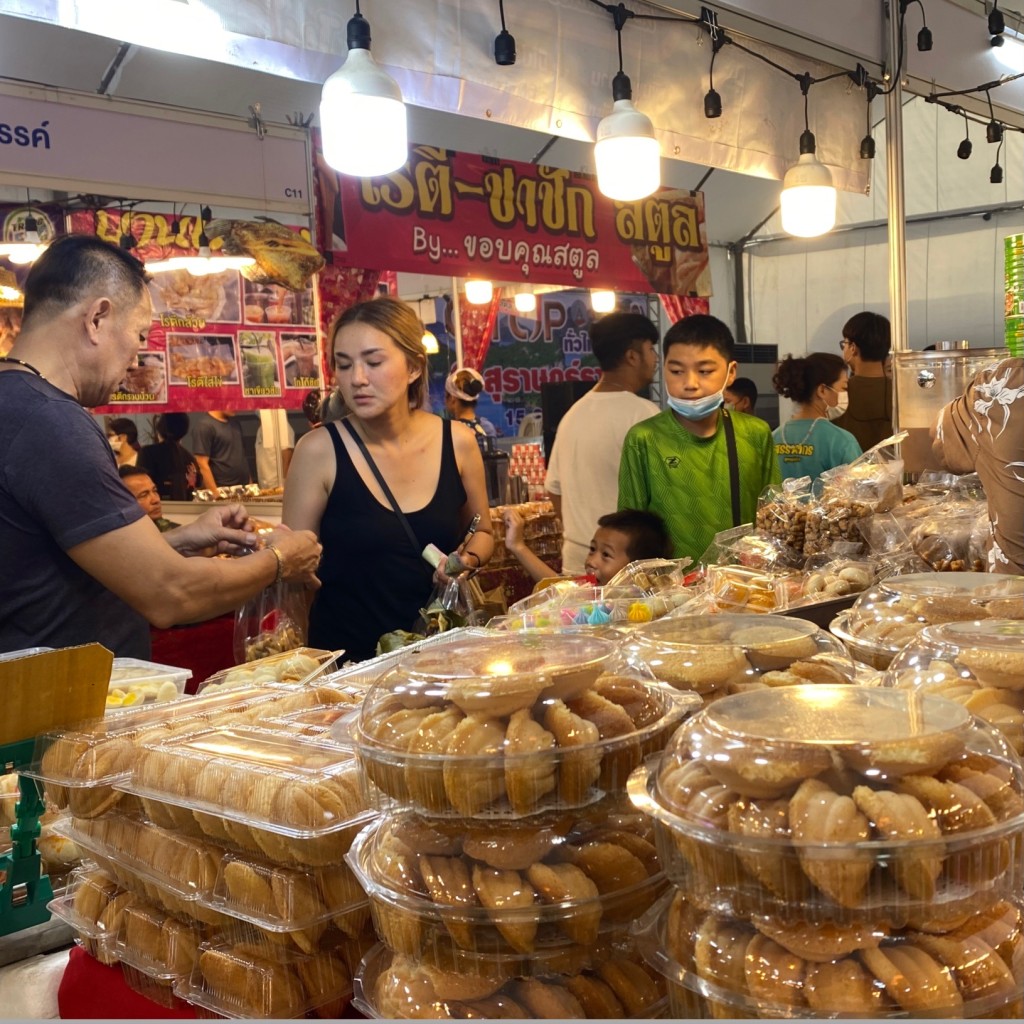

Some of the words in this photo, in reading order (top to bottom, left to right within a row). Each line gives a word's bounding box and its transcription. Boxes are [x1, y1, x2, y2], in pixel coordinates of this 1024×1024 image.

[284, 187, 303, 199] C11
[464, 235, 600, 280] ขอบคุณสตูล
